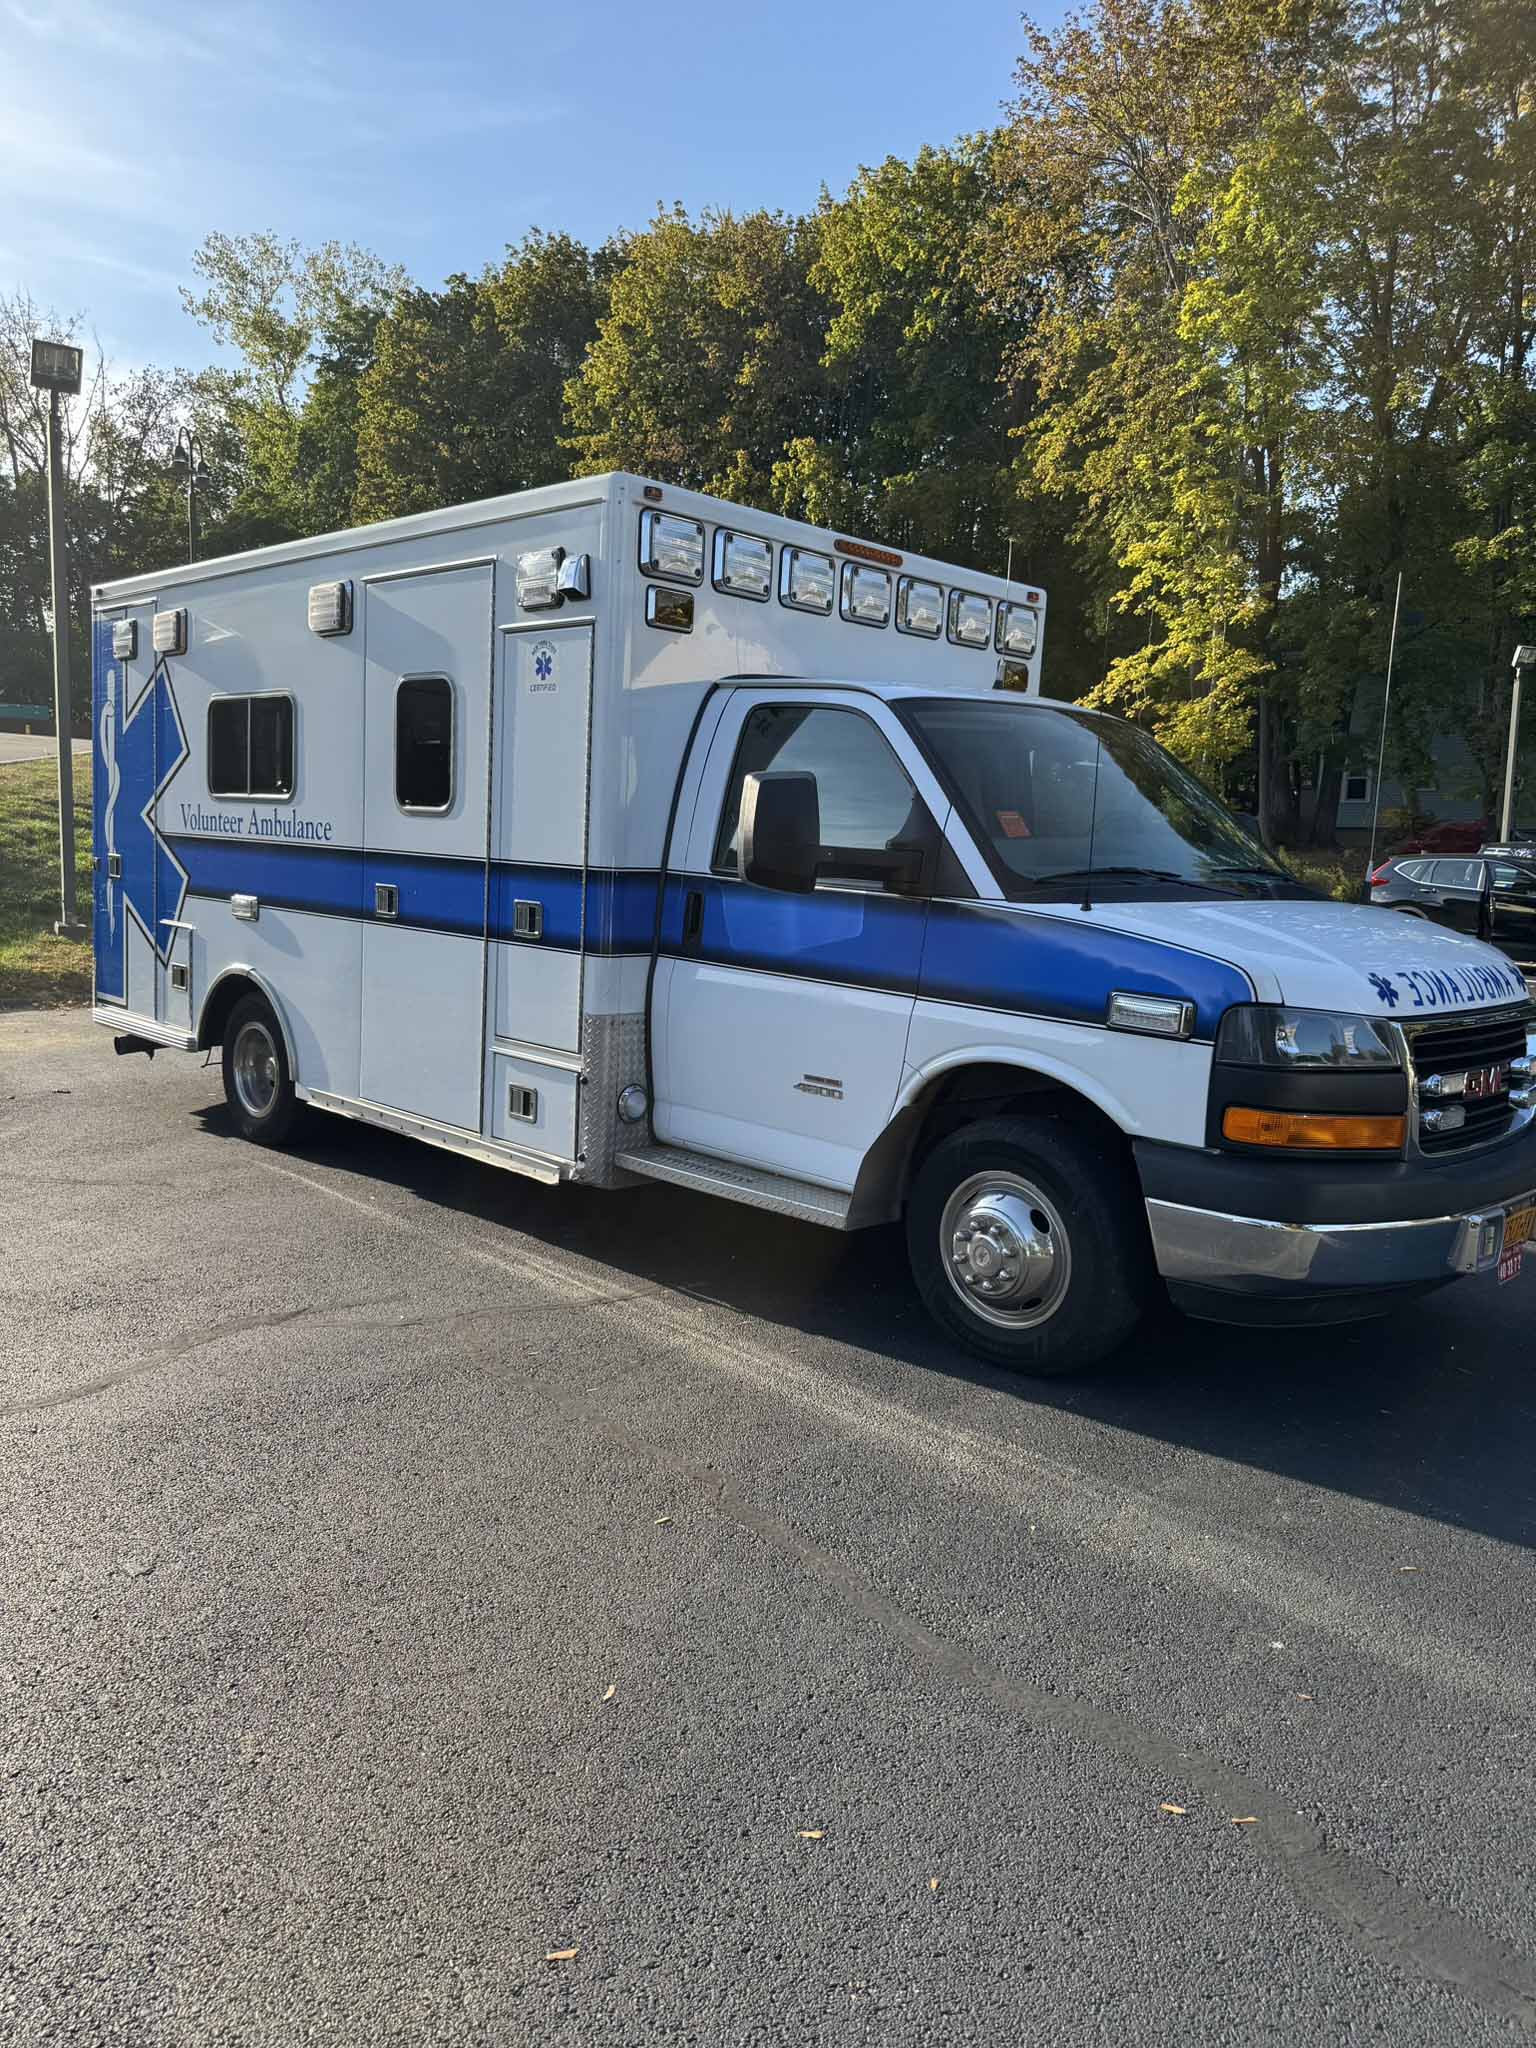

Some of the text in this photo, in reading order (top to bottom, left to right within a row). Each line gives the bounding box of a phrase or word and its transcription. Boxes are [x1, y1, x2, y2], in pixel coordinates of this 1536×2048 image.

[180, 803, 332, 841] Volunteer Ambulance
[1463, 1065, 1502, 1097] GM
